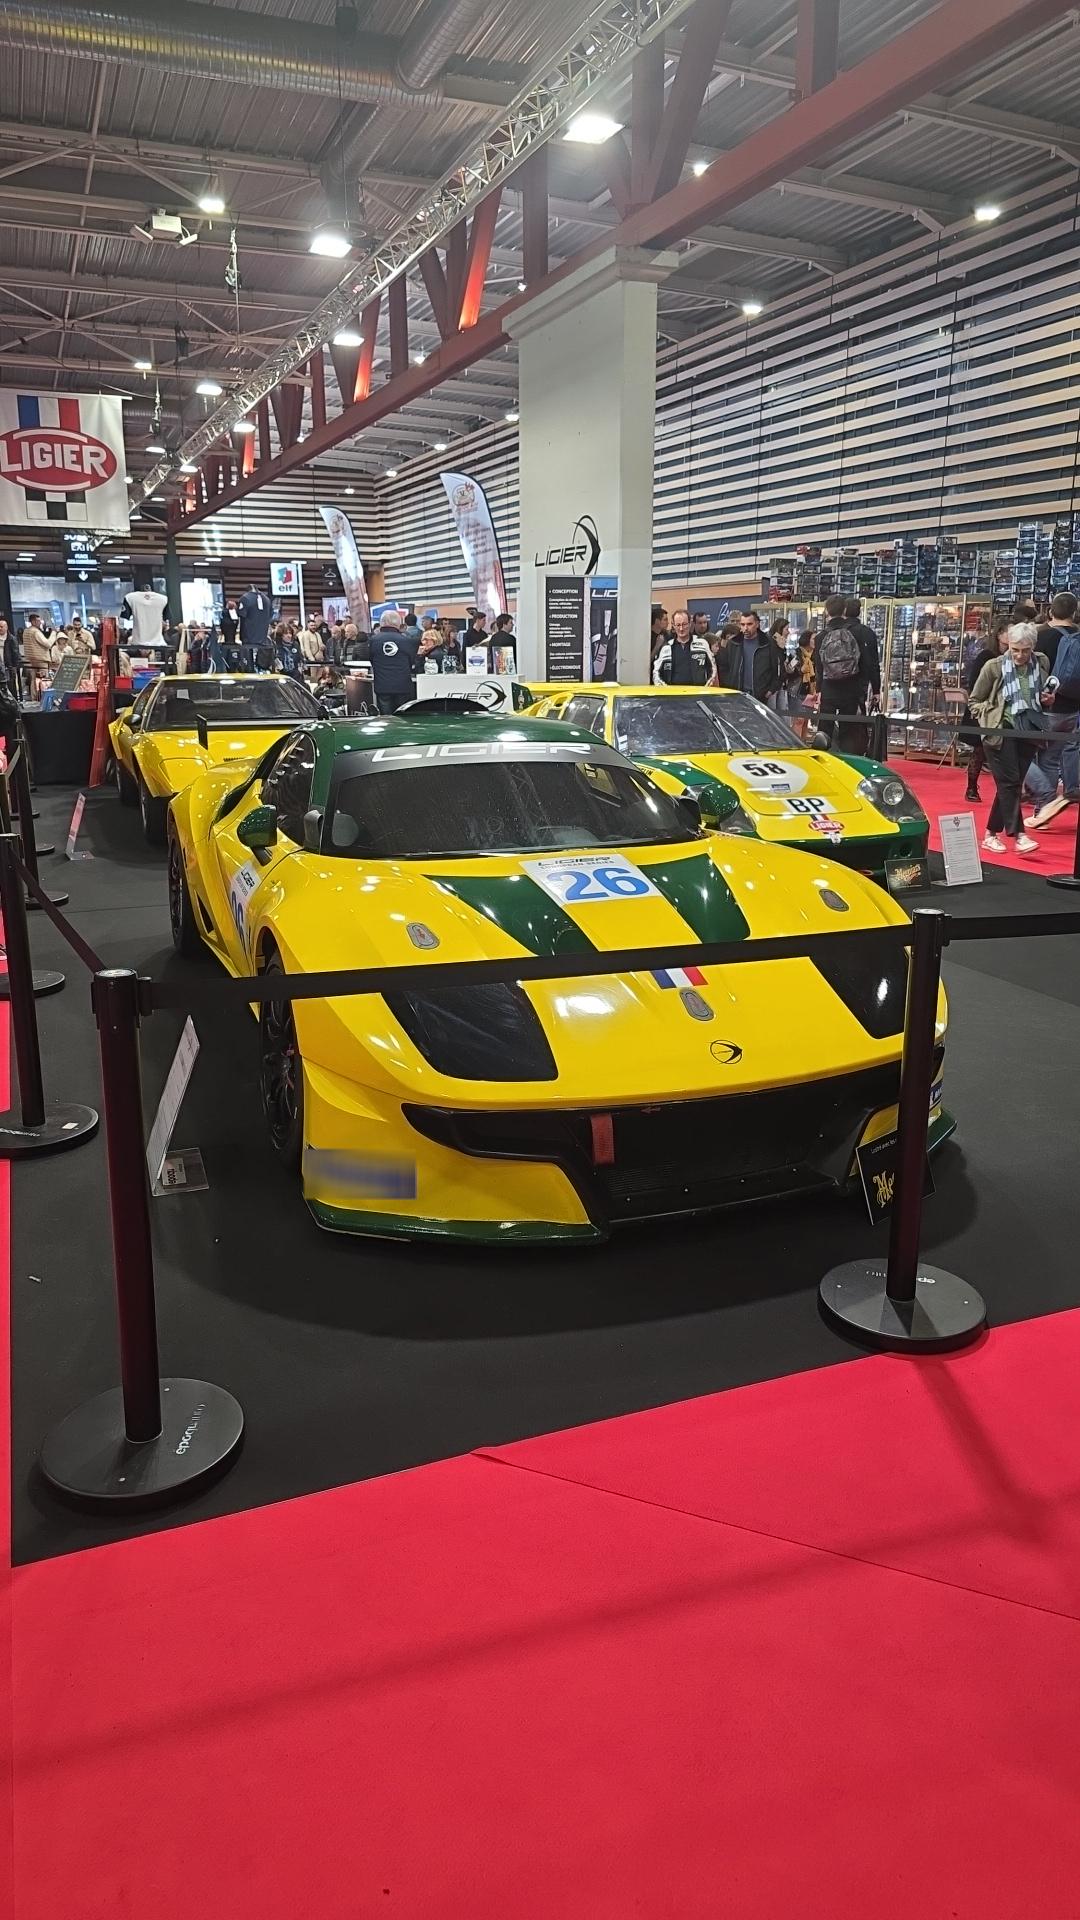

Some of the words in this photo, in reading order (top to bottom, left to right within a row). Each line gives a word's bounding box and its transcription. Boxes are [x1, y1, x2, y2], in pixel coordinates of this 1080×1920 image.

[0, 440, 109, 479] LIGIER
[534, 544, 588, 567] LIGIER
[278, 584, 293, 592] elf
[372, 742, 593, 763] LIGIER
[741, 762, 787, 777] 58
[786, 797, 826, 813] BP
[546, 867, 650, 900] 26
